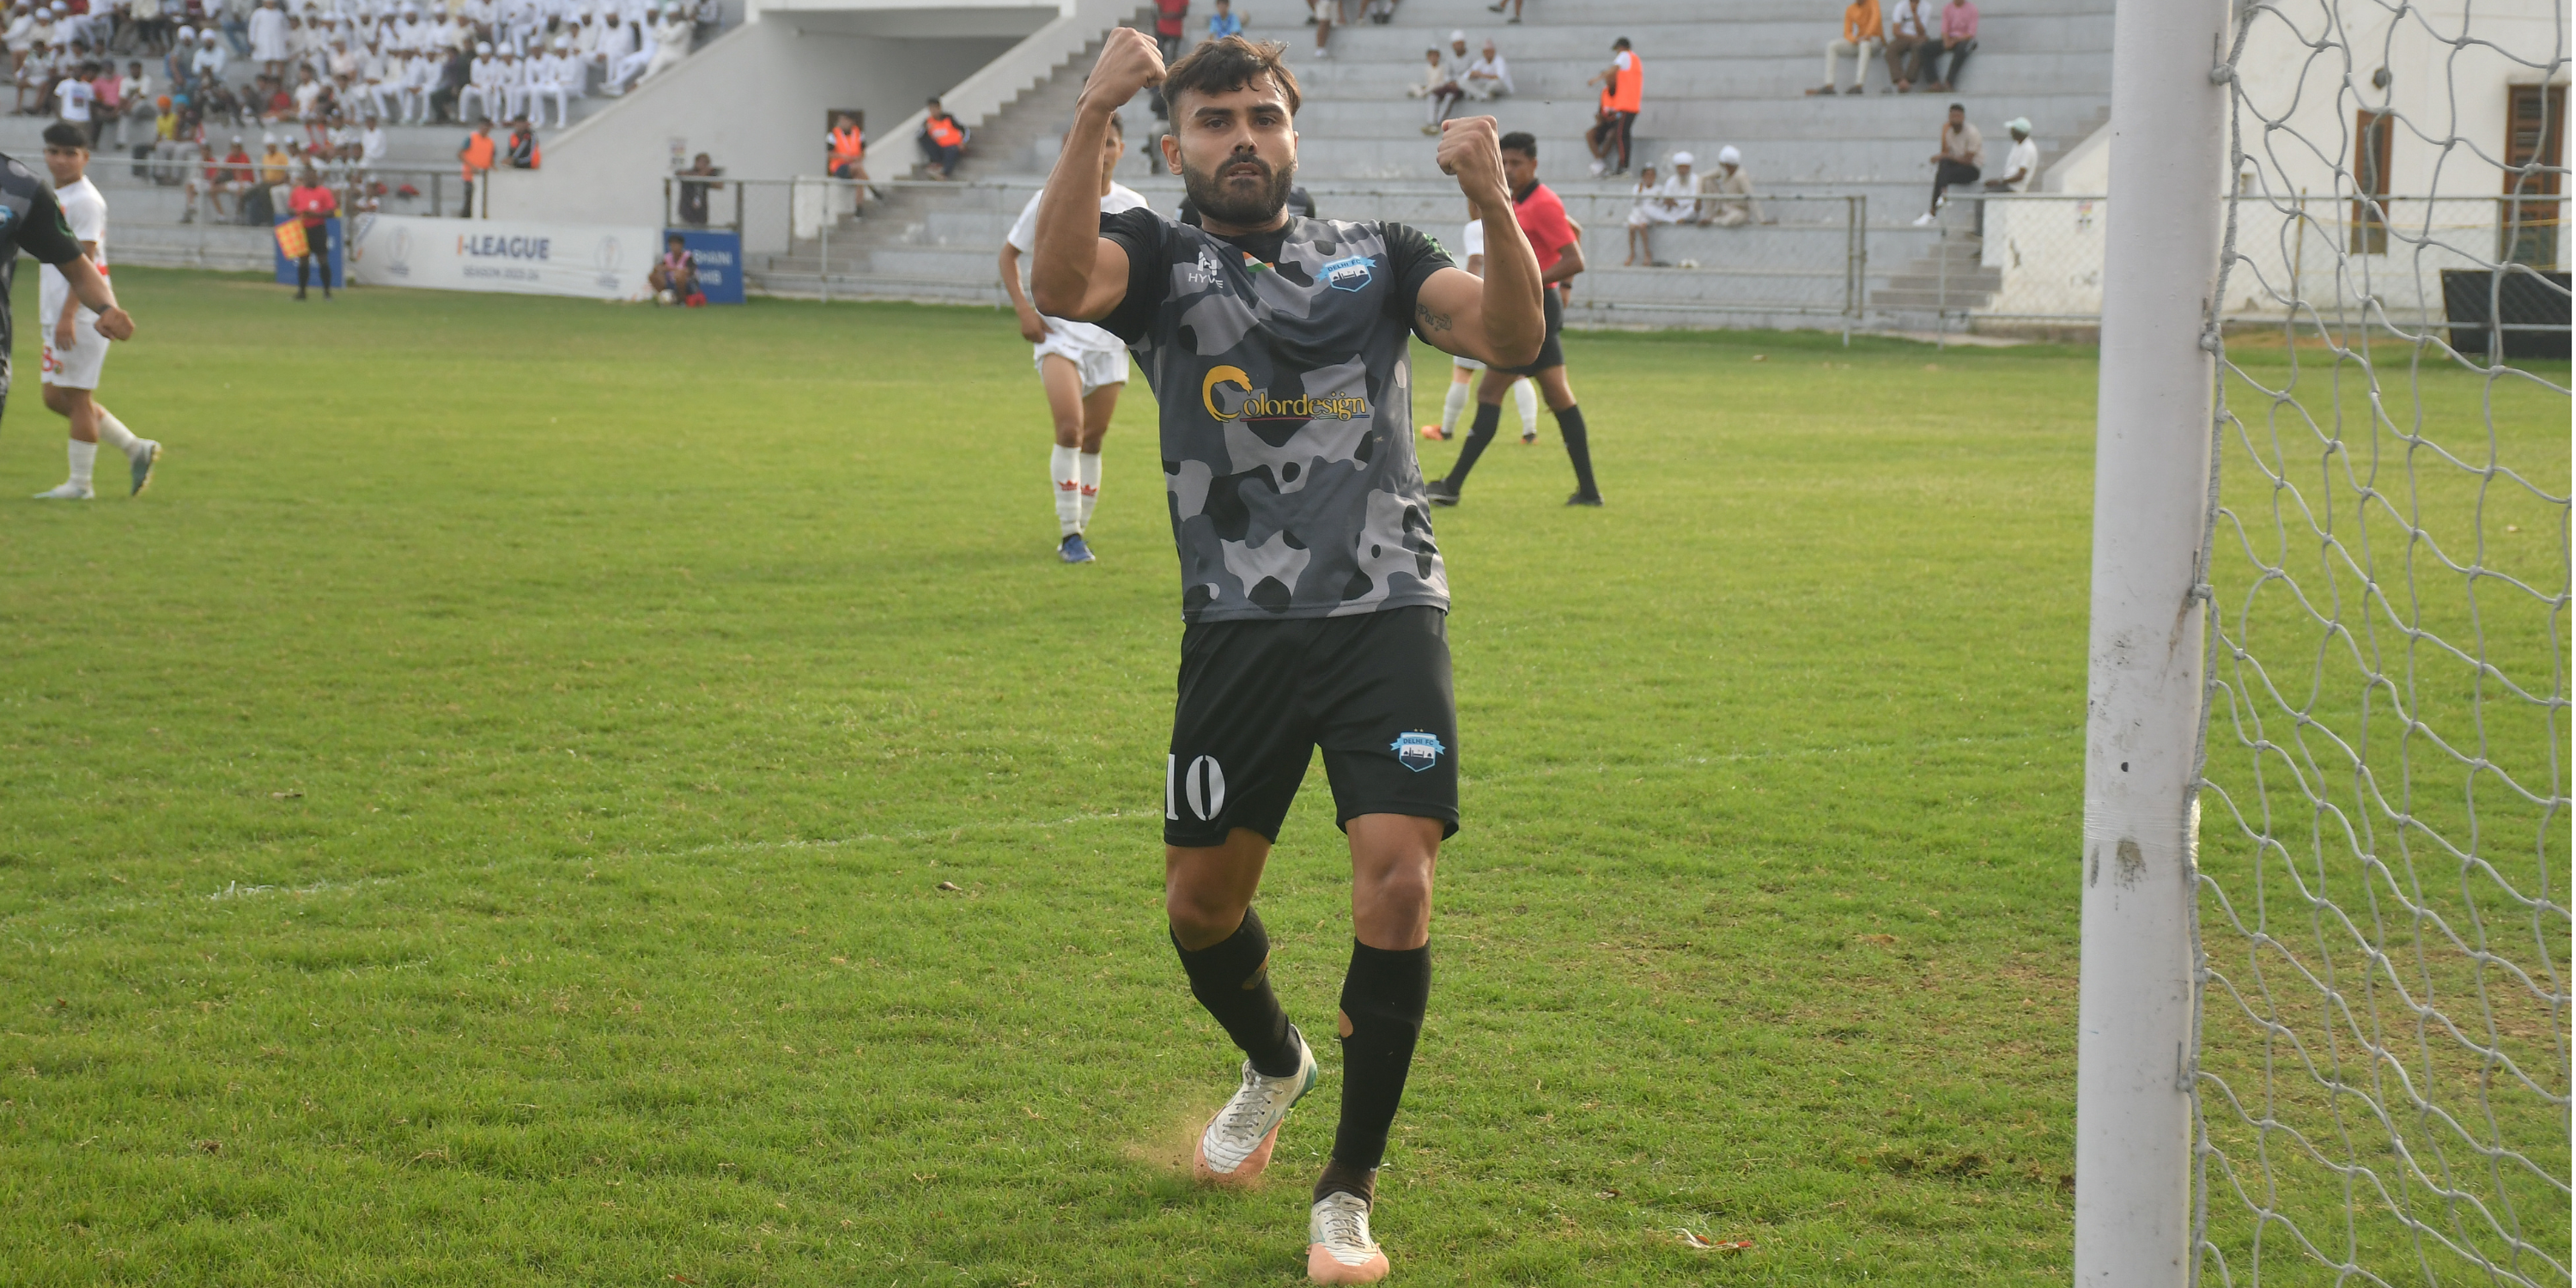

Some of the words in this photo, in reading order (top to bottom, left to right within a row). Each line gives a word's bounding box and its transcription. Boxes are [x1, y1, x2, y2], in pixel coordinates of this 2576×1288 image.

[457, 234, 550, 259] I-LEAGUE
[1327, 263, 1349, 272] DELHI
[1188, 272, 1224, 289] HYVE
[1202, 364, 1367, 422] Colordesign
[1166, 753, 1225, 821] 10
